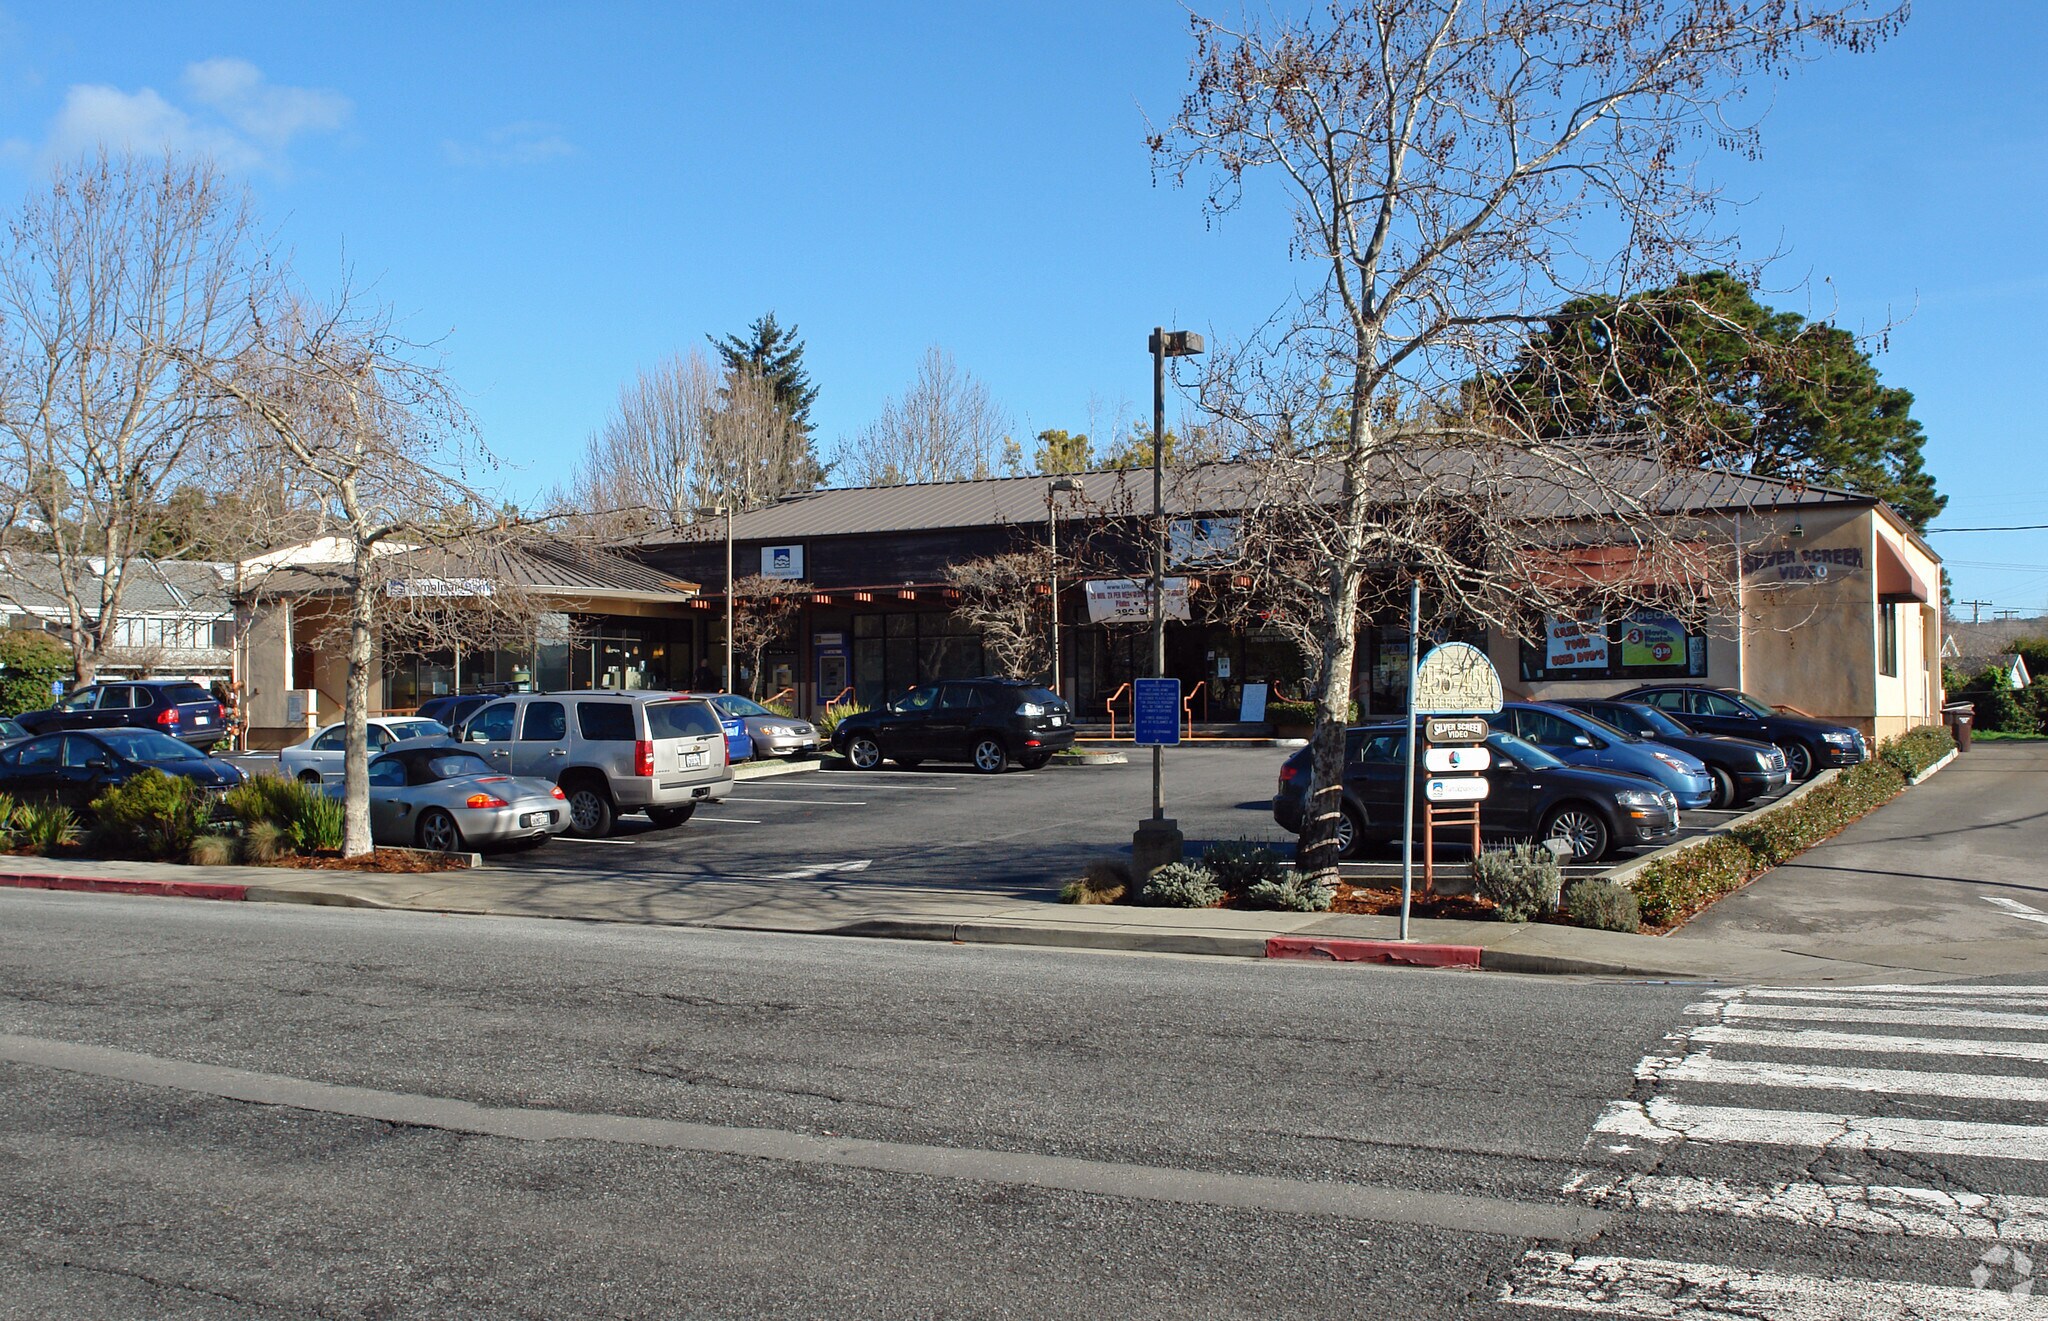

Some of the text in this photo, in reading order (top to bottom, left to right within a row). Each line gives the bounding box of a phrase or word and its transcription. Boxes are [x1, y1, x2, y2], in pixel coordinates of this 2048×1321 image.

[1800, 546, 1864, 569] SCREEN
[1777, 564, 1828, 580] VIDEO
[1630, 630, 1640, 643] 3
[1564, 638, 1591, 651] YOUR
[1551, 653, 1576, 666] USED
[1421, 664, 1493, 695] 453-459
[1433, 722, 1482, 736] SILVER SCREEN
[1448, 730, 1469, 739] VIDEO
